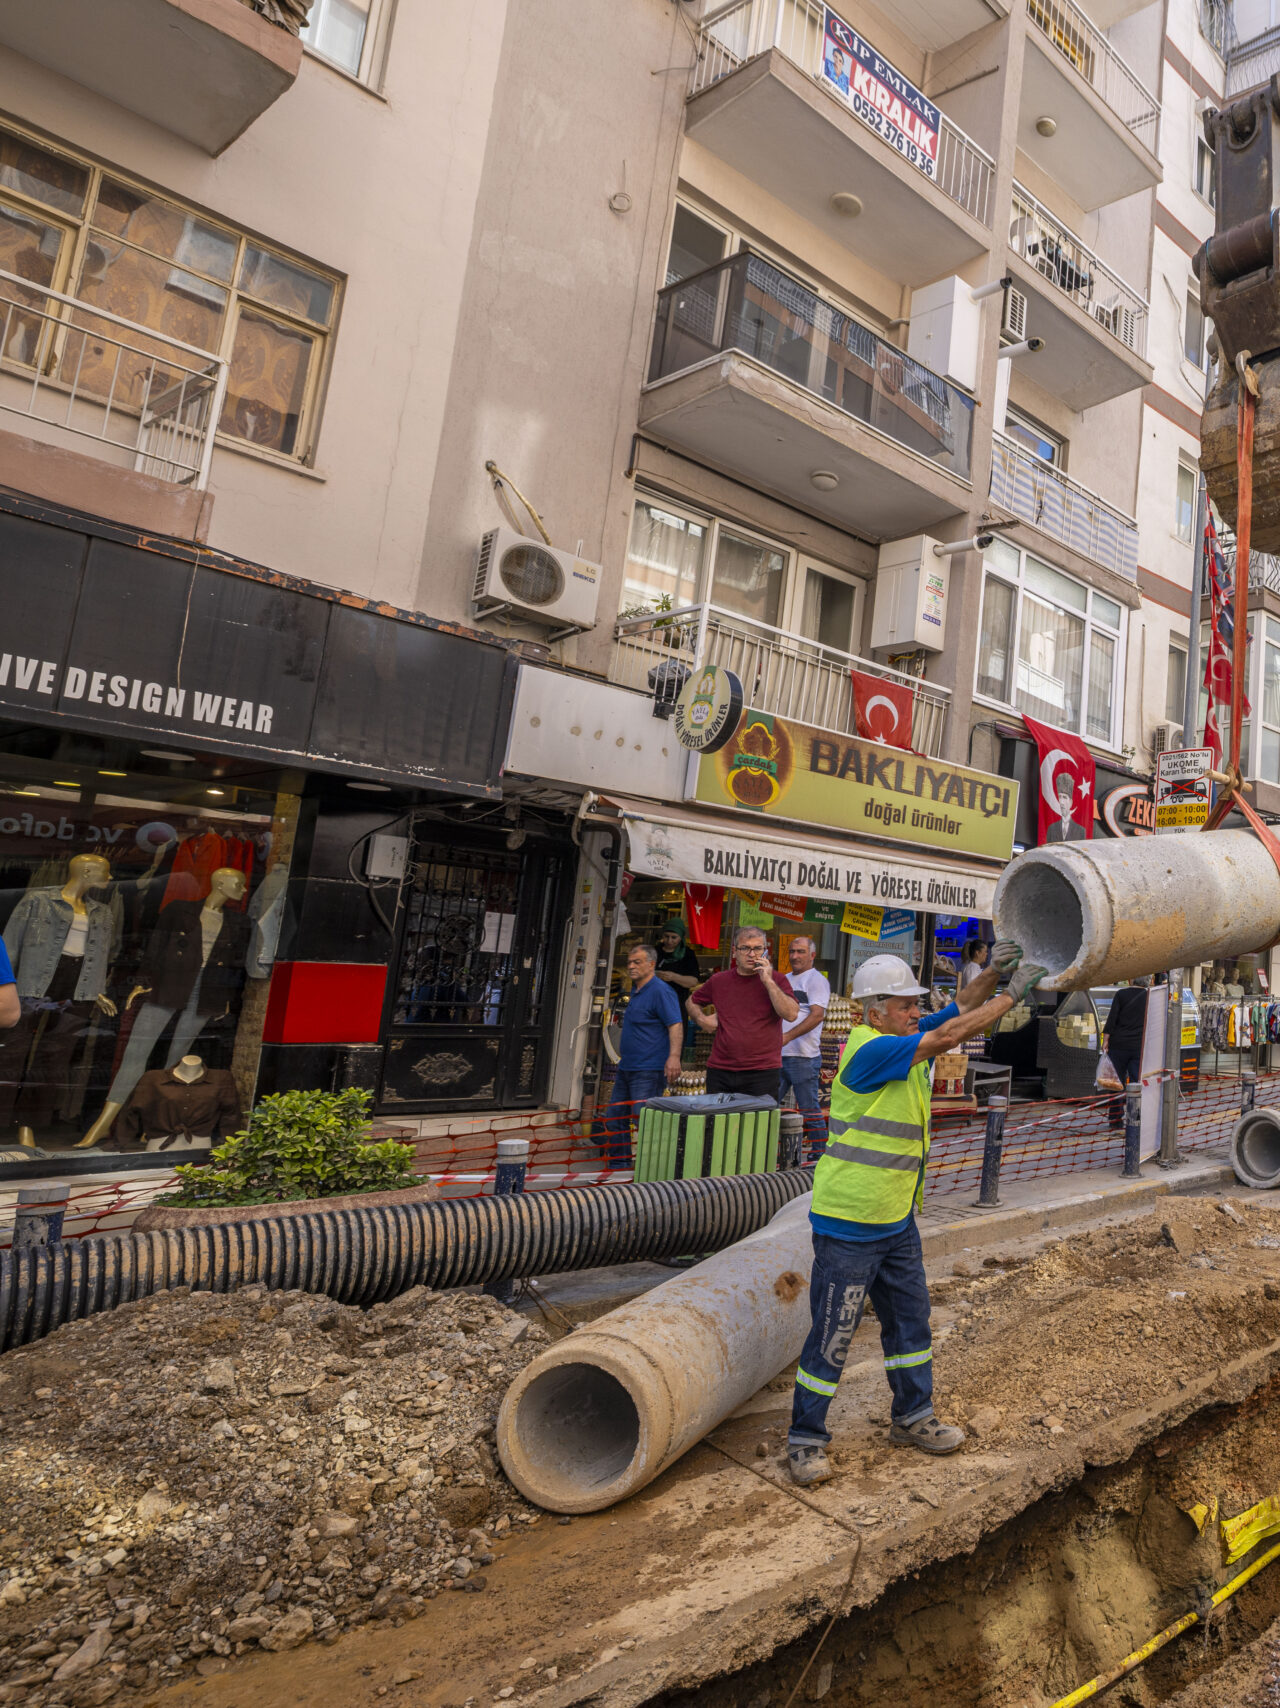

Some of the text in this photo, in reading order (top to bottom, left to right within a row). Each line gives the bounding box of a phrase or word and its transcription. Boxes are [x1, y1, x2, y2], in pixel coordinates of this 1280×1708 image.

[854, 63, 935, 157] KİRALIK
[874, 58, 935, 125] EMLAK
[853, 93, 933, 176] 0552 376 19 36
[63, 666, 186, 718] DESIGN
[193, 691, 274, 734] WEAR
[1167, 760, 1199, 769] UKOME
[864, 797, 962, 835] doğal ürünler
[1157, 816, 1177, 826] 16:00
[1184, 815, 1206, 824] 19:00
[1158, 806, 1178, 815] 07:00
[1184, 805, 1206, 814] 10:00
[703, 848, 977, 909] BAKLİYATÇI DOĞAL VE YÖRESEL ÜRÜNLER
